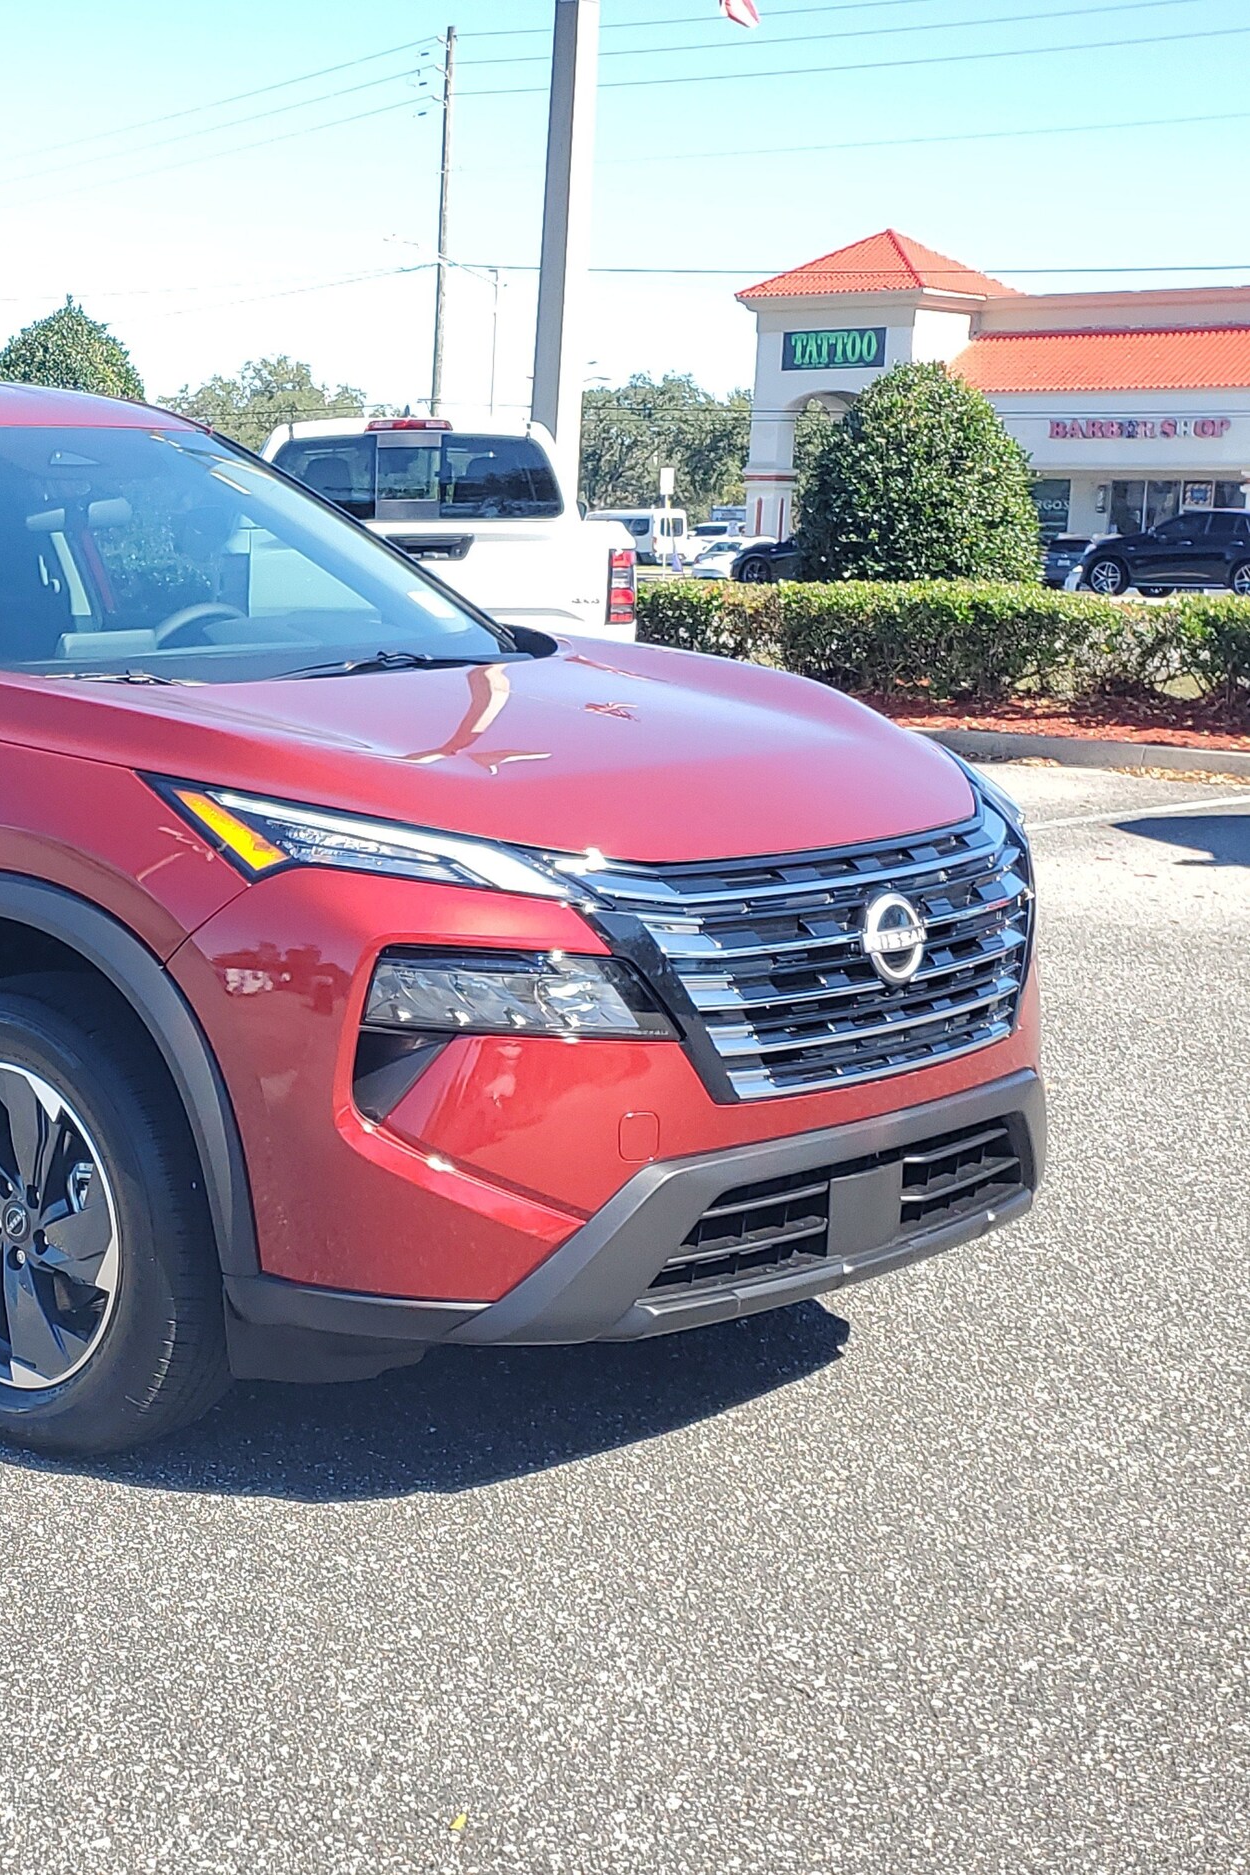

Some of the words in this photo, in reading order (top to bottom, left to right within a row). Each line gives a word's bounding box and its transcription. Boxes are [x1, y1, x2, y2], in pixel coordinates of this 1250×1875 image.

[791, 330, 877, 365] TATTOO
[1049, 418, 1157, 439] BARBER
[1160, 416, 1231, 439] SHOP
[863, 926, 927, 953] NISSAN
